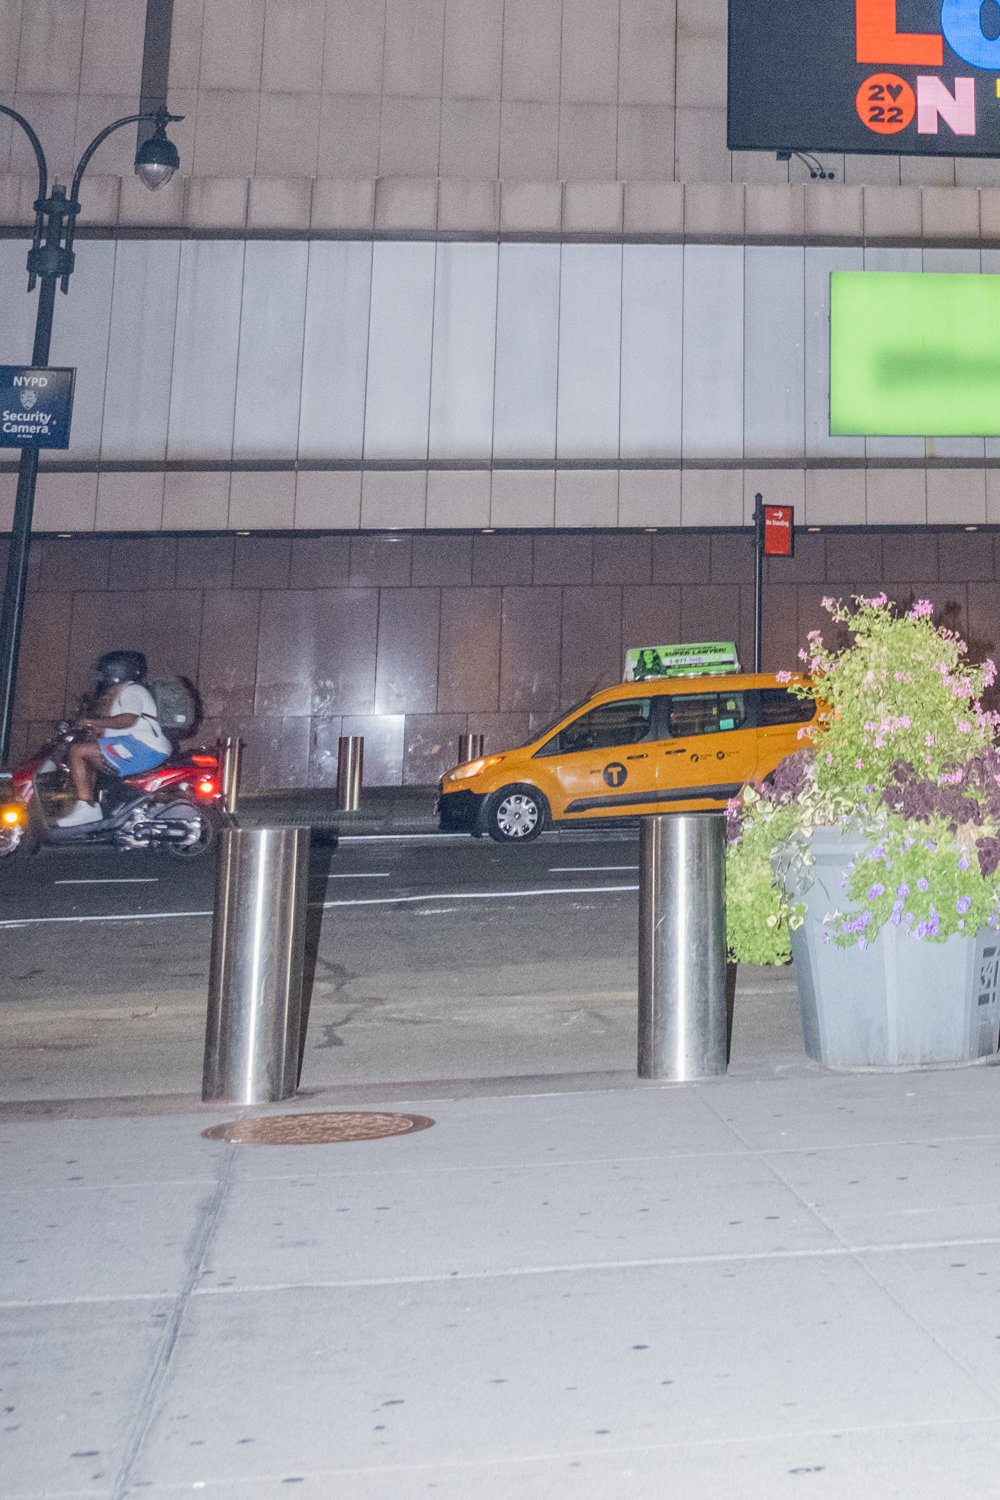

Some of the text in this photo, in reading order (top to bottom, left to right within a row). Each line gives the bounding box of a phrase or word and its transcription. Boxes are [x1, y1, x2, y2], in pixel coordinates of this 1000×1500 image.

[13, 376, 48, 387] NYPD
[2, 410, 52, 425] Security
[2, 422, 49, 434] Camera
